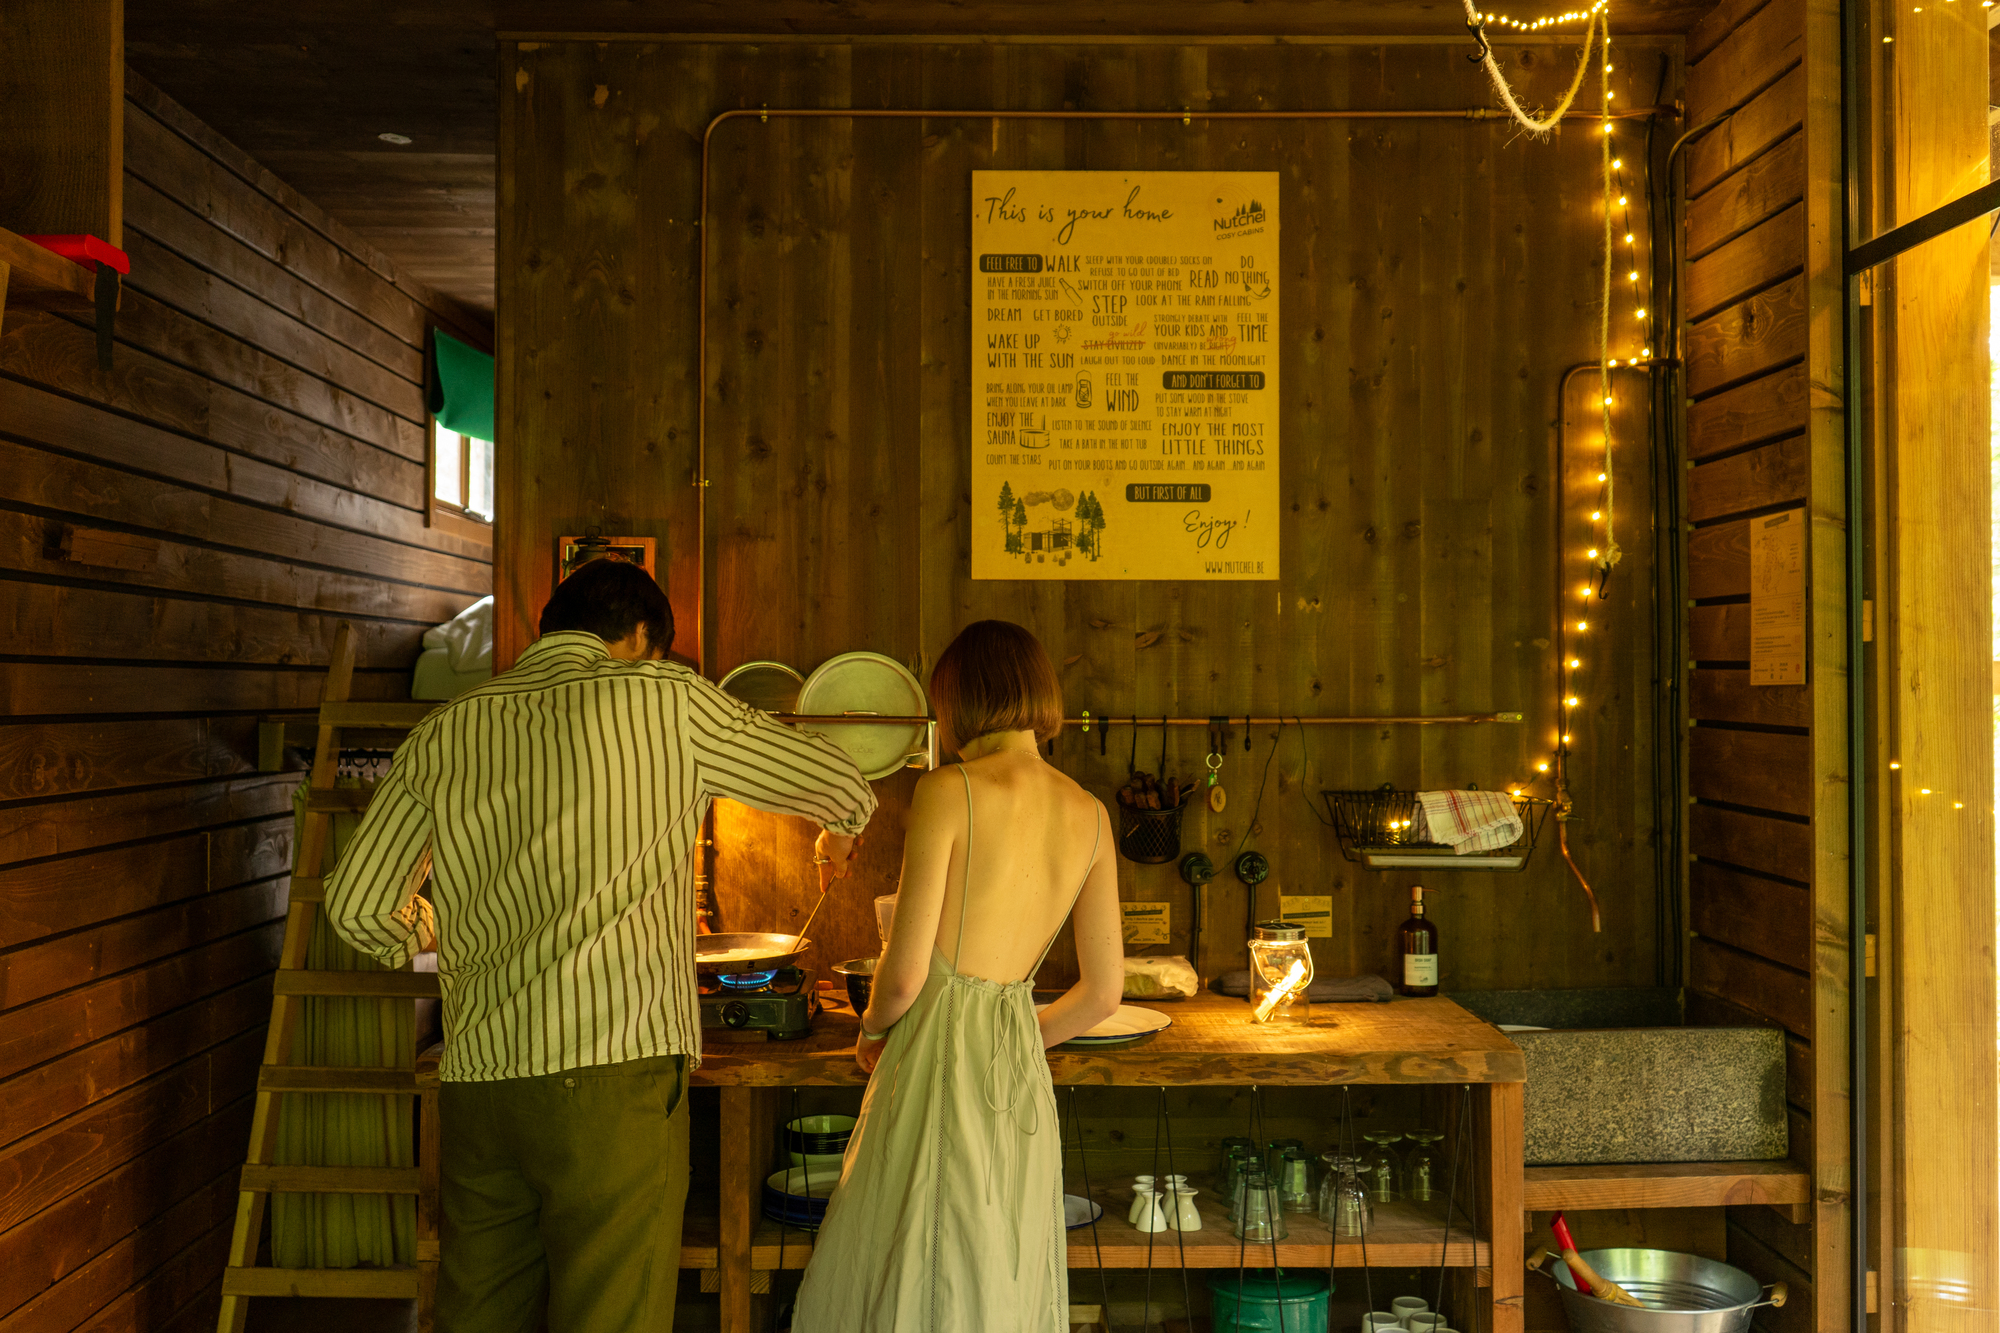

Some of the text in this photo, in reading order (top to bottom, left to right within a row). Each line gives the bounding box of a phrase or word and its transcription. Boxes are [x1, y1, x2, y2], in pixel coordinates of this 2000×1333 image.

[984, 185, 1174, 245] This is your home
[1213, 209, 1266, 232] Nutchel
[1216, 226, 1265, 241] COSY CABINS
[986, 256, 1038, 271] FEEL FREE TO
[1045, 255, 1081, 272] WALK
[1085, 255, 1213, 265] SLEEP WITH YOUR (DOUBLE) SOCKS ON
[1240, 255, 1254, 269] DO
[1090, 267, 1180, 277] REFUSE TO GO OUT OF BED
[1225, 271, 1270, 285] NOTHING
[987, 277, 1056, 288] HAVE A FRESH JUICE
[1078, 280, 1182, 291] SWITCH OFF YOUR PHONE
[1189, 270, 1219, 288] READ
[987, 289, 1059, 300] IN THE MORNING SUN
[1136, 295, 1252, 306] LOOK AT THE RAIN FALLING
[1092, 295, 1127, 314] STEP
[987, 308, 1022, 321] DREAM
[1033, 309, 1083, 321] GET BORED
[1092, 315, 1128, 327] OUTSIDE
[1153, 314, 1228, 323] STRONGLY DEBATE WITH
[1236, 313, 1269, 322] FEEL THE
[1154, 324, 1228, 337] YOUR KIDS AND
[1238, 324, 1269, 342] TIME
[987, 333, 1041, 349] WAKE UP
[1083, 340, 1104, 351] STAY
[1154, 341, 1197, 351] (INVARIABLY)
[1200, 341, 1207, 351] BE
[987, 353, 1074, 368] WITH THE SUN
[1080, 356, 1155, 365] LAUGH OUT TOO LOUD
[1161, 355, 1266, 366] DANCE IN THE MOONLIGHT
[1106, 373, 1139, 386] FEEL THE
[1171, 372, 1260, 388] AND DON'T FORGET TO
[986, 383, 1074, 394] BRING ALONG YOUR OIL LAMP
[986, 396, 1066, 407] WHEN YOU LEAVE AT DARK
[1105, 389, 1139, 412] WIND
[1155, 393, 1249, 404] PUT SOME WOOD IN THE STOVE
[1156, 406, 1232, 417] TO STAY WARM AT NIGHT
[987, 412, 1034, 427] ENJOY THE
[1052, 420, 1152, 431] LISTEN TO THE SOUND OF SILENCE
[1162, 423, 1265, 436] ENJOY THE MOST
[987, 430, 1016, 445] SAUNA
[1059, 439, 1147, 449] TAKE A BATH IN THE HOT TUB
[1162, 439, 1264, 455] LITTLE THINGS
[986, 454, 1042, 465] COUNT THE STARS
[1049, 460, 1060, 470] PUT
[1063, 460, 1072, 470] ON
[1074, 460, 1091, 470] YOUR
[1093, 460, 1113, 470] BOOTS
[1115, 460, 1127, 470] AND
[1128, 460, 1138, 470] GO
[1140, 460, 1165, 470] OUTSIDE
[1193, 460, 1205, 470] AND
[1247, 460, 1265, 470] AGAIN
[1134, 486, 1203, 500] BUT FIRST OF ALL
[1183, 509, 1237, 549] Enjoy
[1205, 561, 1265, 574] WWW.NUTCHEL.BE
